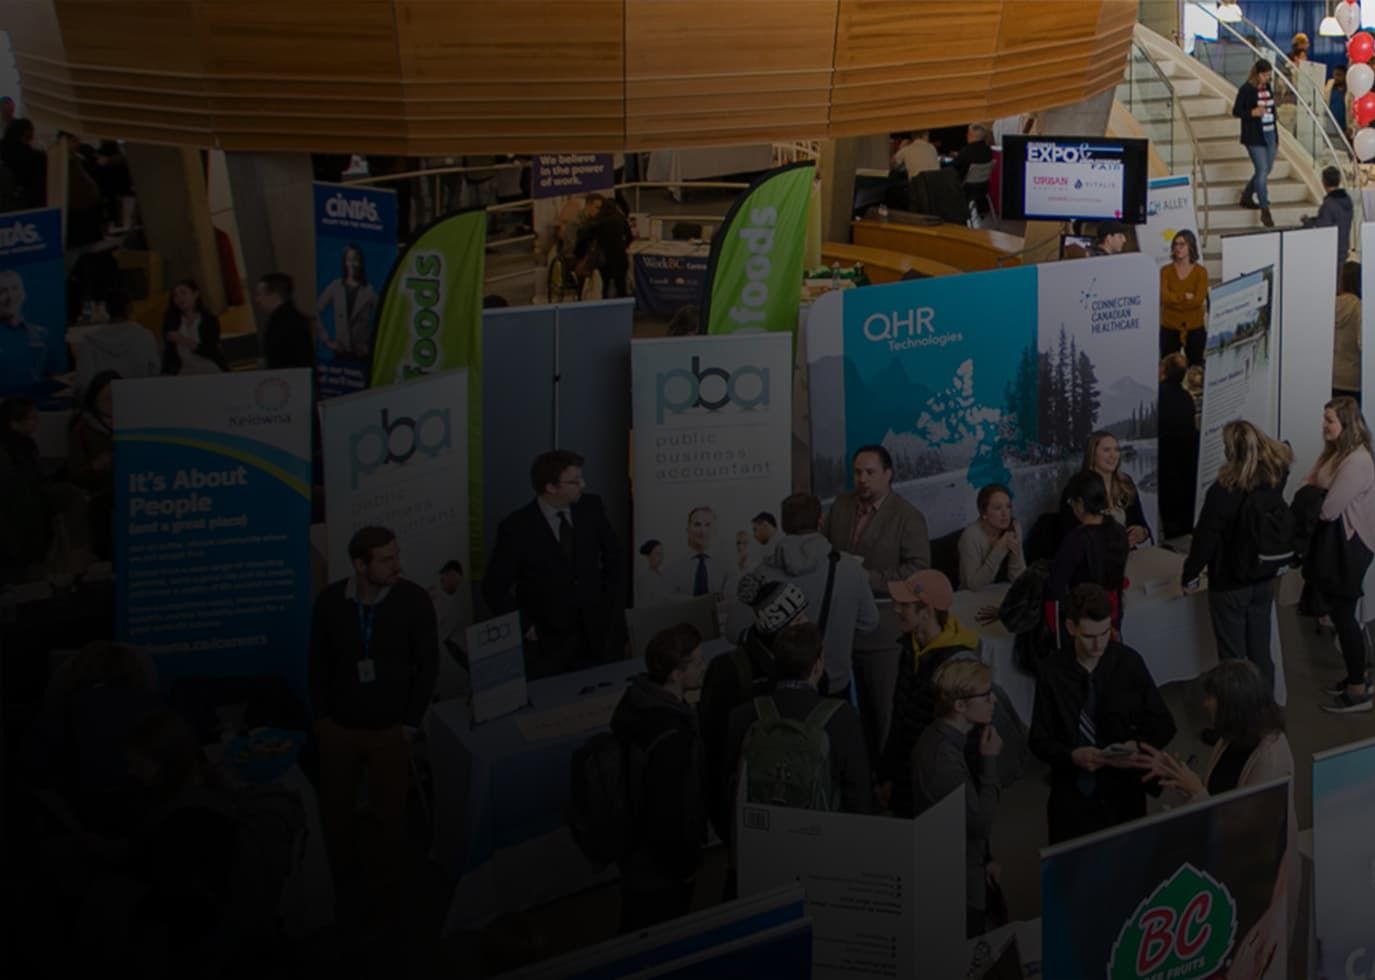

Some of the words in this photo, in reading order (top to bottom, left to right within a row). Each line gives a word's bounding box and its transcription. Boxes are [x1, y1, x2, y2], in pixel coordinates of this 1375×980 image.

[1028, 146, 1079, 163] EXPO
[540, 167, 551, 177] in
[552, 166, 570, 177] the
[540, 177, 553, 188] of
[1091, 295, 1141, 311] CONNECTING
[863, 306, 936, 342] QHR
[1091, 308, 1131, 322] CANADIAN
[1091, 318, 1139, 334] HEALTHCARE
[887, 331, 964, 352] Technologies
[655, 355, 770, 425] pba
[350, 408, 450, 491] pba
[128, 472, 166, 493] It's
[169, 465, 249, 490] About
[128, 491, 213, 520] People
[1136, 890, 1212, 976] BC
